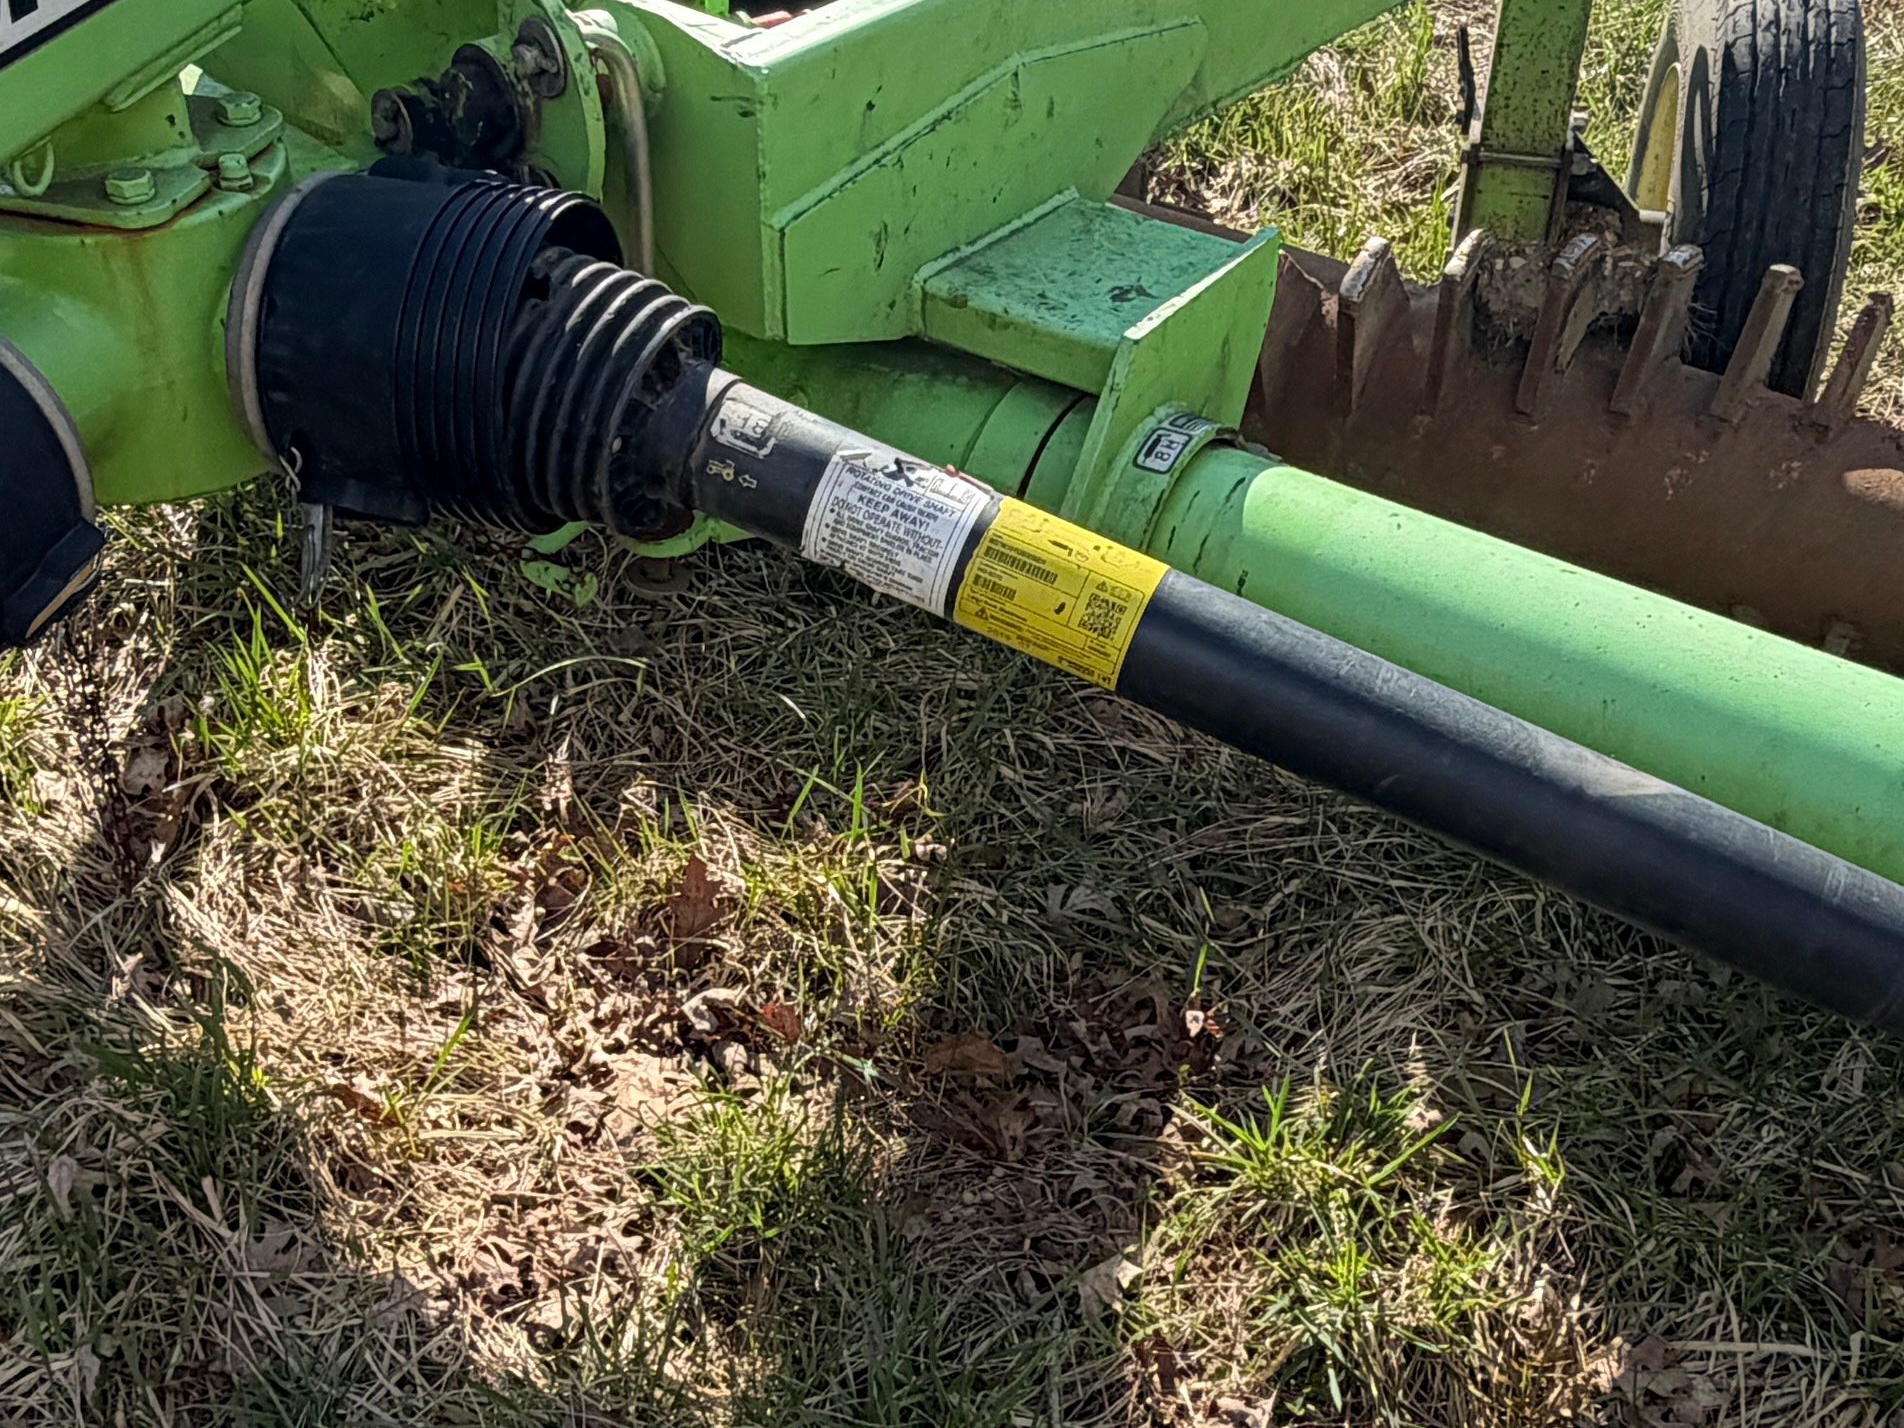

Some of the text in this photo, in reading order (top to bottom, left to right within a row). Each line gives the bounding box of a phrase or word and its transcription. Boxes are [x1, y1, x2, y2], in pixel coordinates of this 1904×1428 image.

[831, 496, 846, 509] DO
[861, 509, 902, 532] OPERATE
[857, 494, 930, 531] KEEP AWAY!
